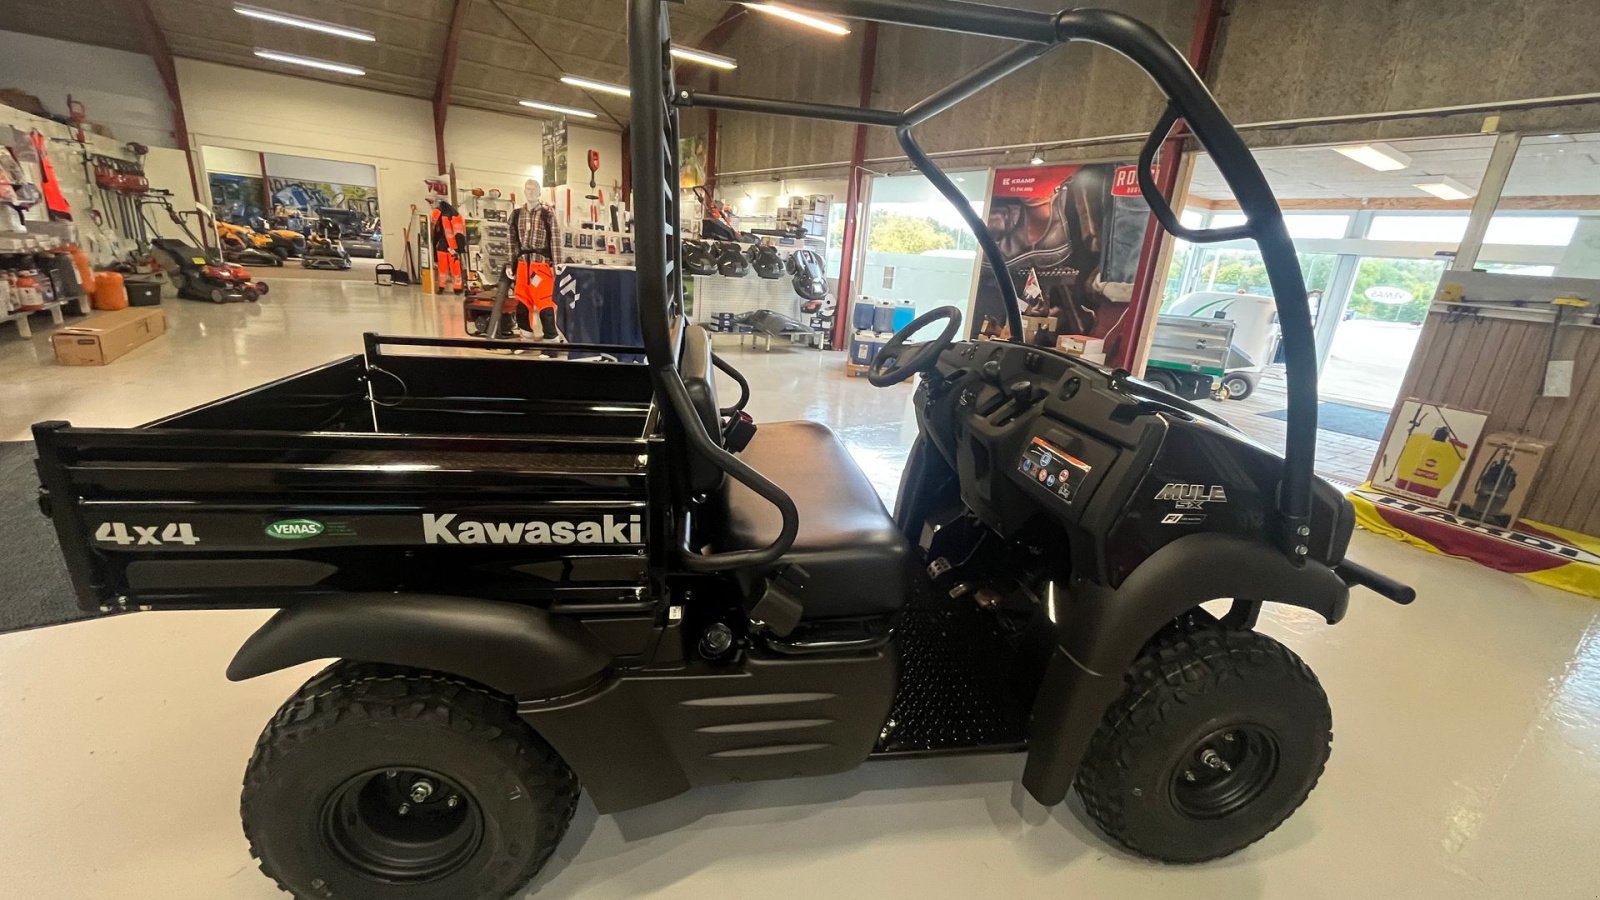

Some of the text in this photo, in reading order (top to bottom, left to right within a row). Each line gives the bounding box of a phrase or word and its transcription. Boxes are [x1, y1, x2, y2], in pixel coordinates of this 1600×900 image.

[1154, 483, 1228, 503] MULE
[1174, 500, 1205, 510] SX
[95, 522, 201, 545] 4x4
[273, 523, 318, 534] VEMAS
[422, 513, 642, 544] Kawasaki
